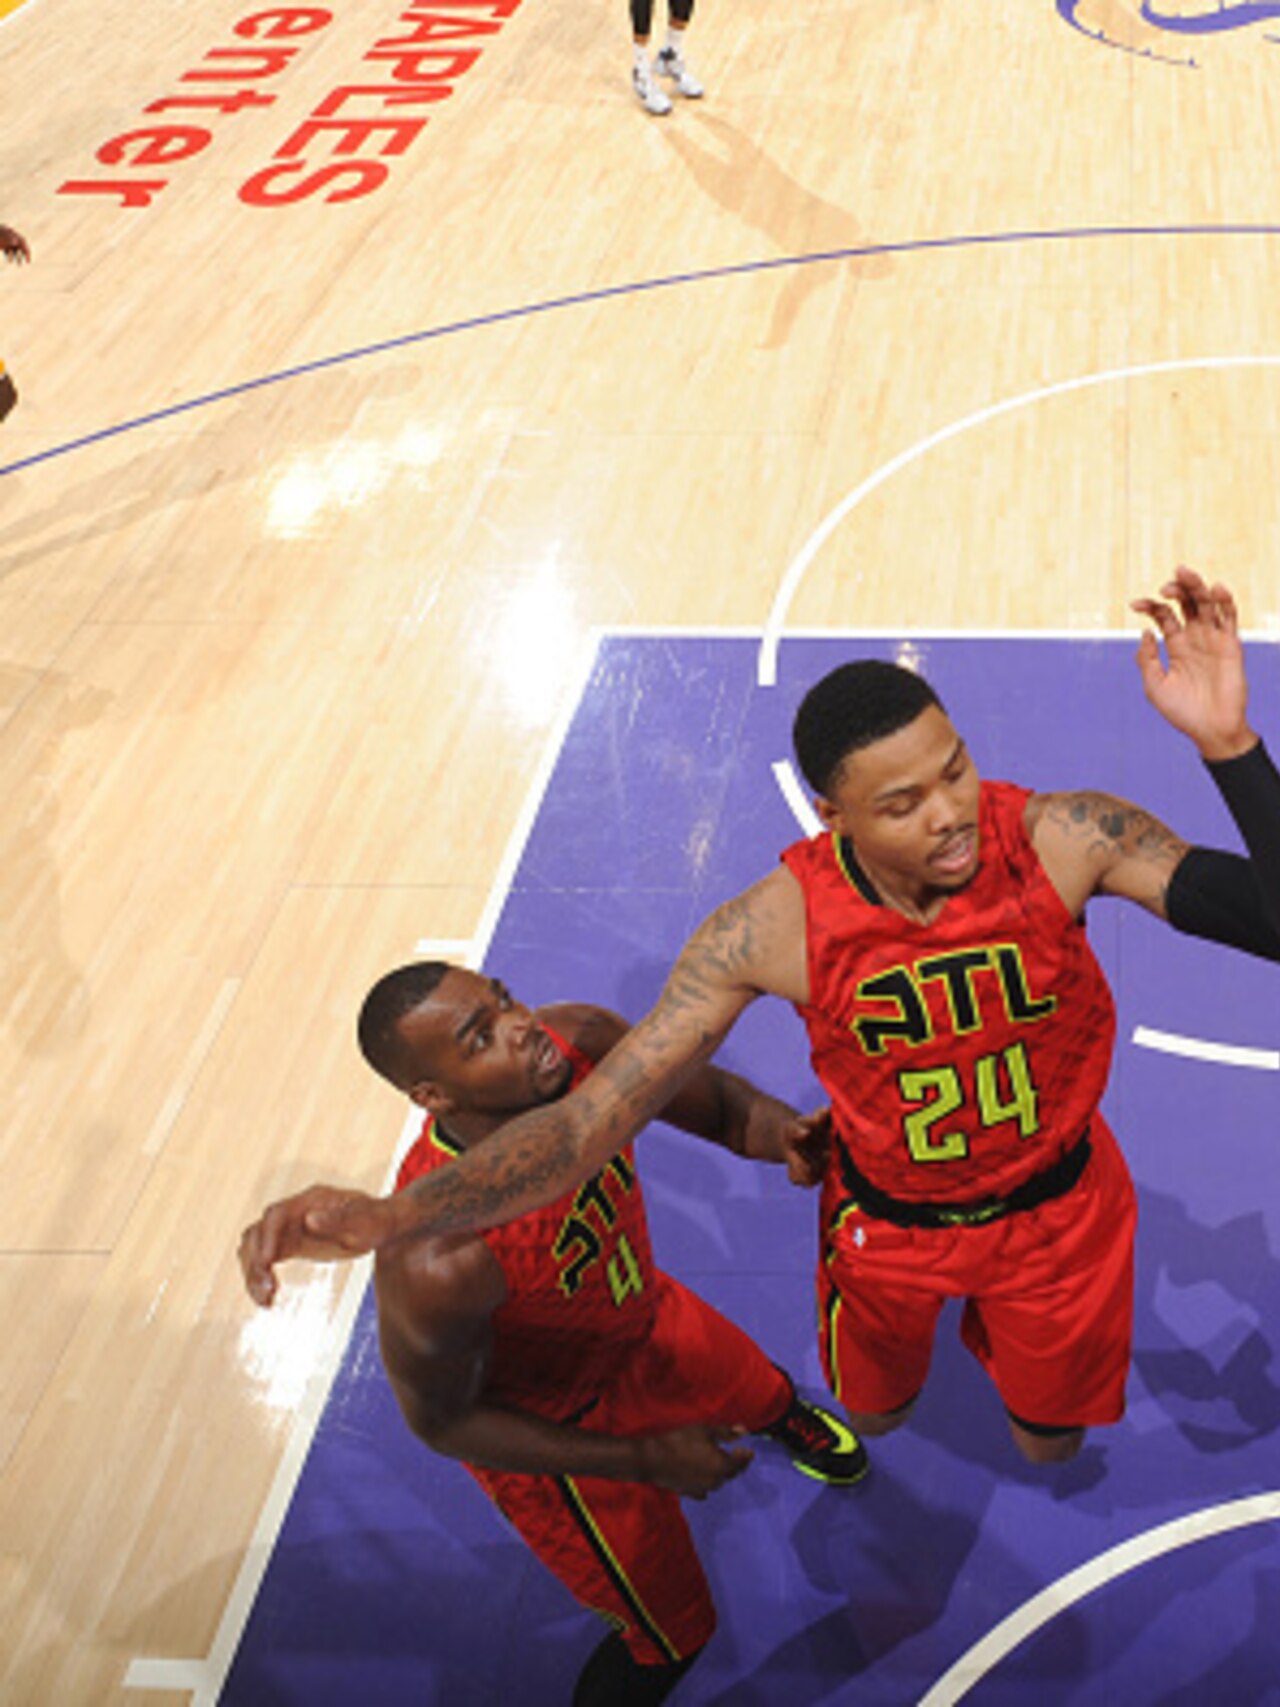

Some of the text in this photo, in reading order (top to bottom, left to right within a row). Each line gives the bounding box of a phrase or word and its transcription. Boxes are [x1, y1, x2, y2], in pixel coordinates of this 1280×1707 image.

[849, 943, 1058, 1055] ATL
[898, 1042, 1040, 1164] 24
[605, 1232, 644, 1307] 4
